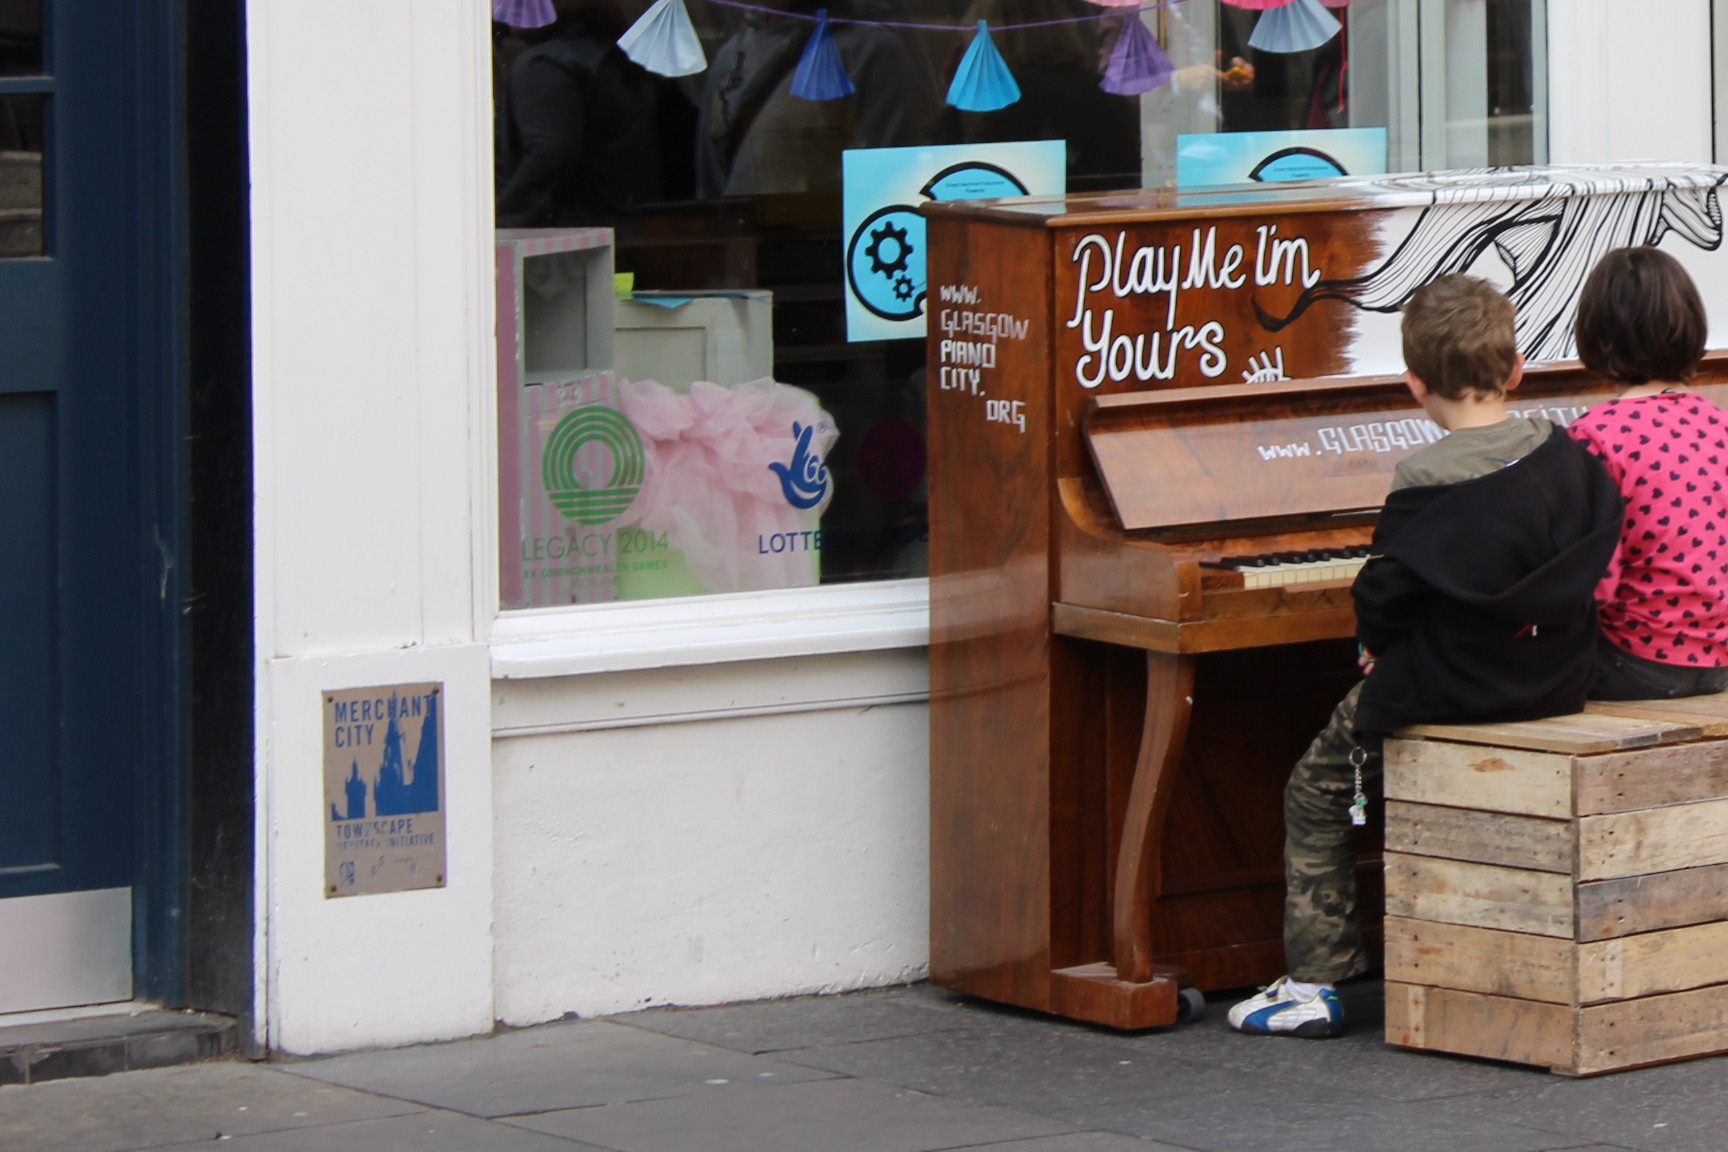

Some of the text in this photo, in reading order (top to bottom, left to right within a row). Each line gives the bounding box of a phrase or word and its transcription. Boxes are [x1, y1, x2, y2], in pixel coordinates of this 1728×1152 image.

[939, 309, 1030, 344] GLASGOW
[940, 339, 996, 369] PIANO
[1075, 308, 1229, 390] Yours
[986, 400, 1027, 434] ORG
[521, 529, 670, 561] LEGACY 2014
[334, 695, 433, 724] MERCHANT
[335, 722, 376, 748] CITY
